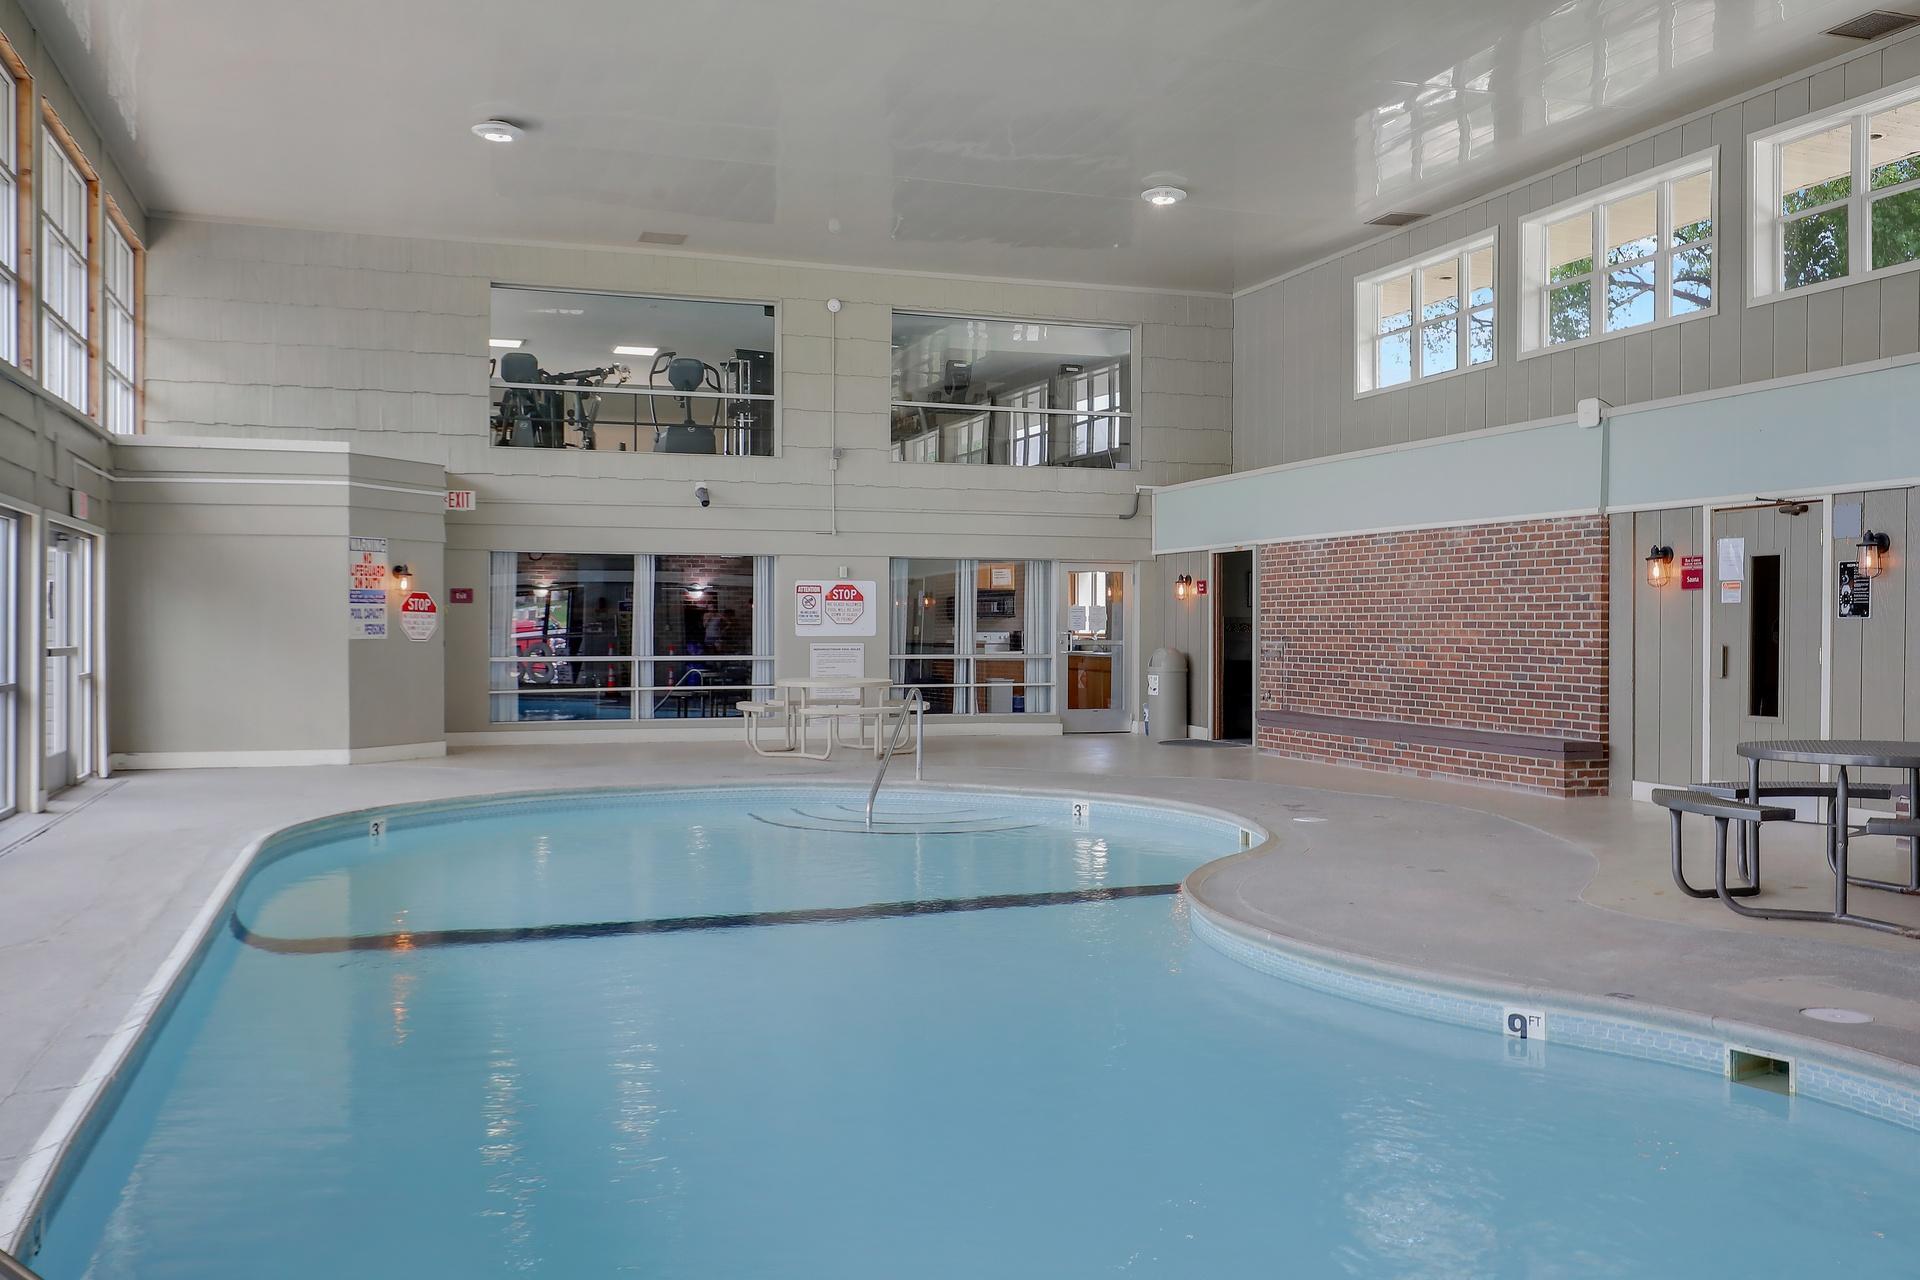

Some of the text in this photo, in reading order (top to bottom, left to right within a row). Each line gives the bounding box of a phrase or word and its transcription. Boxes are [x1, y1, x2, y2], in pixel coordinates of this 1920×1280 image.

[449, 491, 471, 508] EXIT
[363, 553, 372, 564] NO
[351, 564, 385, 577] LIFEGUARD
[354, 577, 381, 588] ON DUTY
[832, 589, 857, 600] STOP
[408, 598, 431, 611] STOP
[350, 608, 385, 619] POOL CAPACITY
[364, 624, 385, 635] PERSONS
[1074, 804, 1082, 816] 3
[371, 822, 379, 836] 3
[1507, 1013, 1542, 1039] 9 FT
